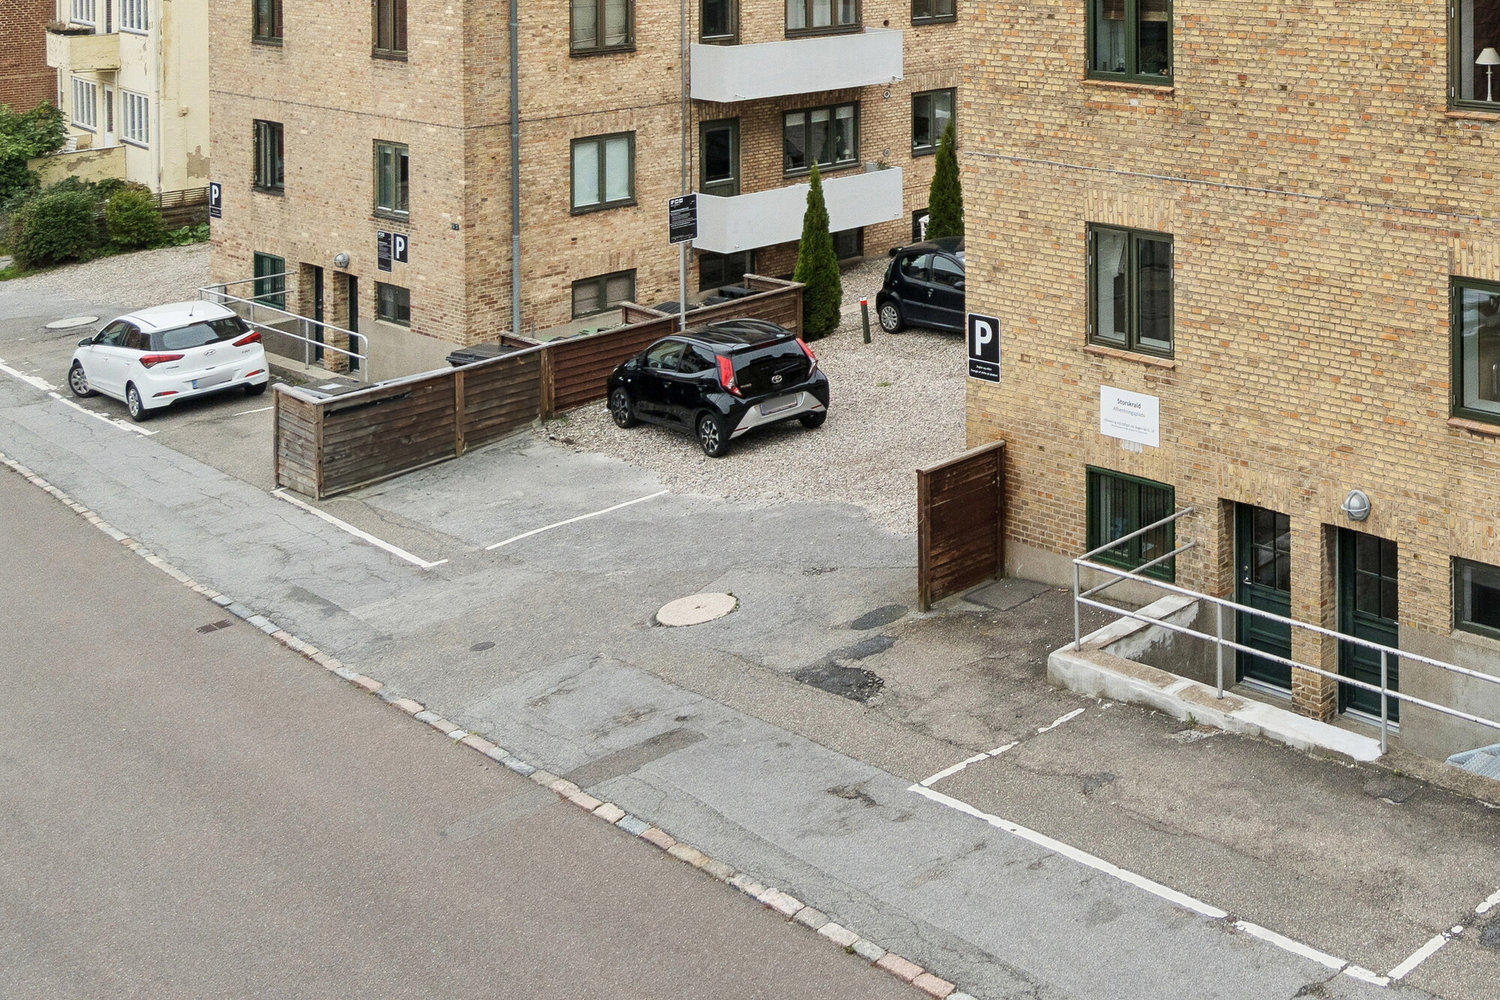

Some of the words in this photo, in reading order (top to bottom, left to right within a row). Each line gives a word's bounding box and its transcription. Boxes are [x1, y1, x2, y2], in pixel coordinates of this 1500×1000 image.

[211, 184, 219, 205] P
[396, 236, 405, 259] P
[975, 319, 993, 356] P
